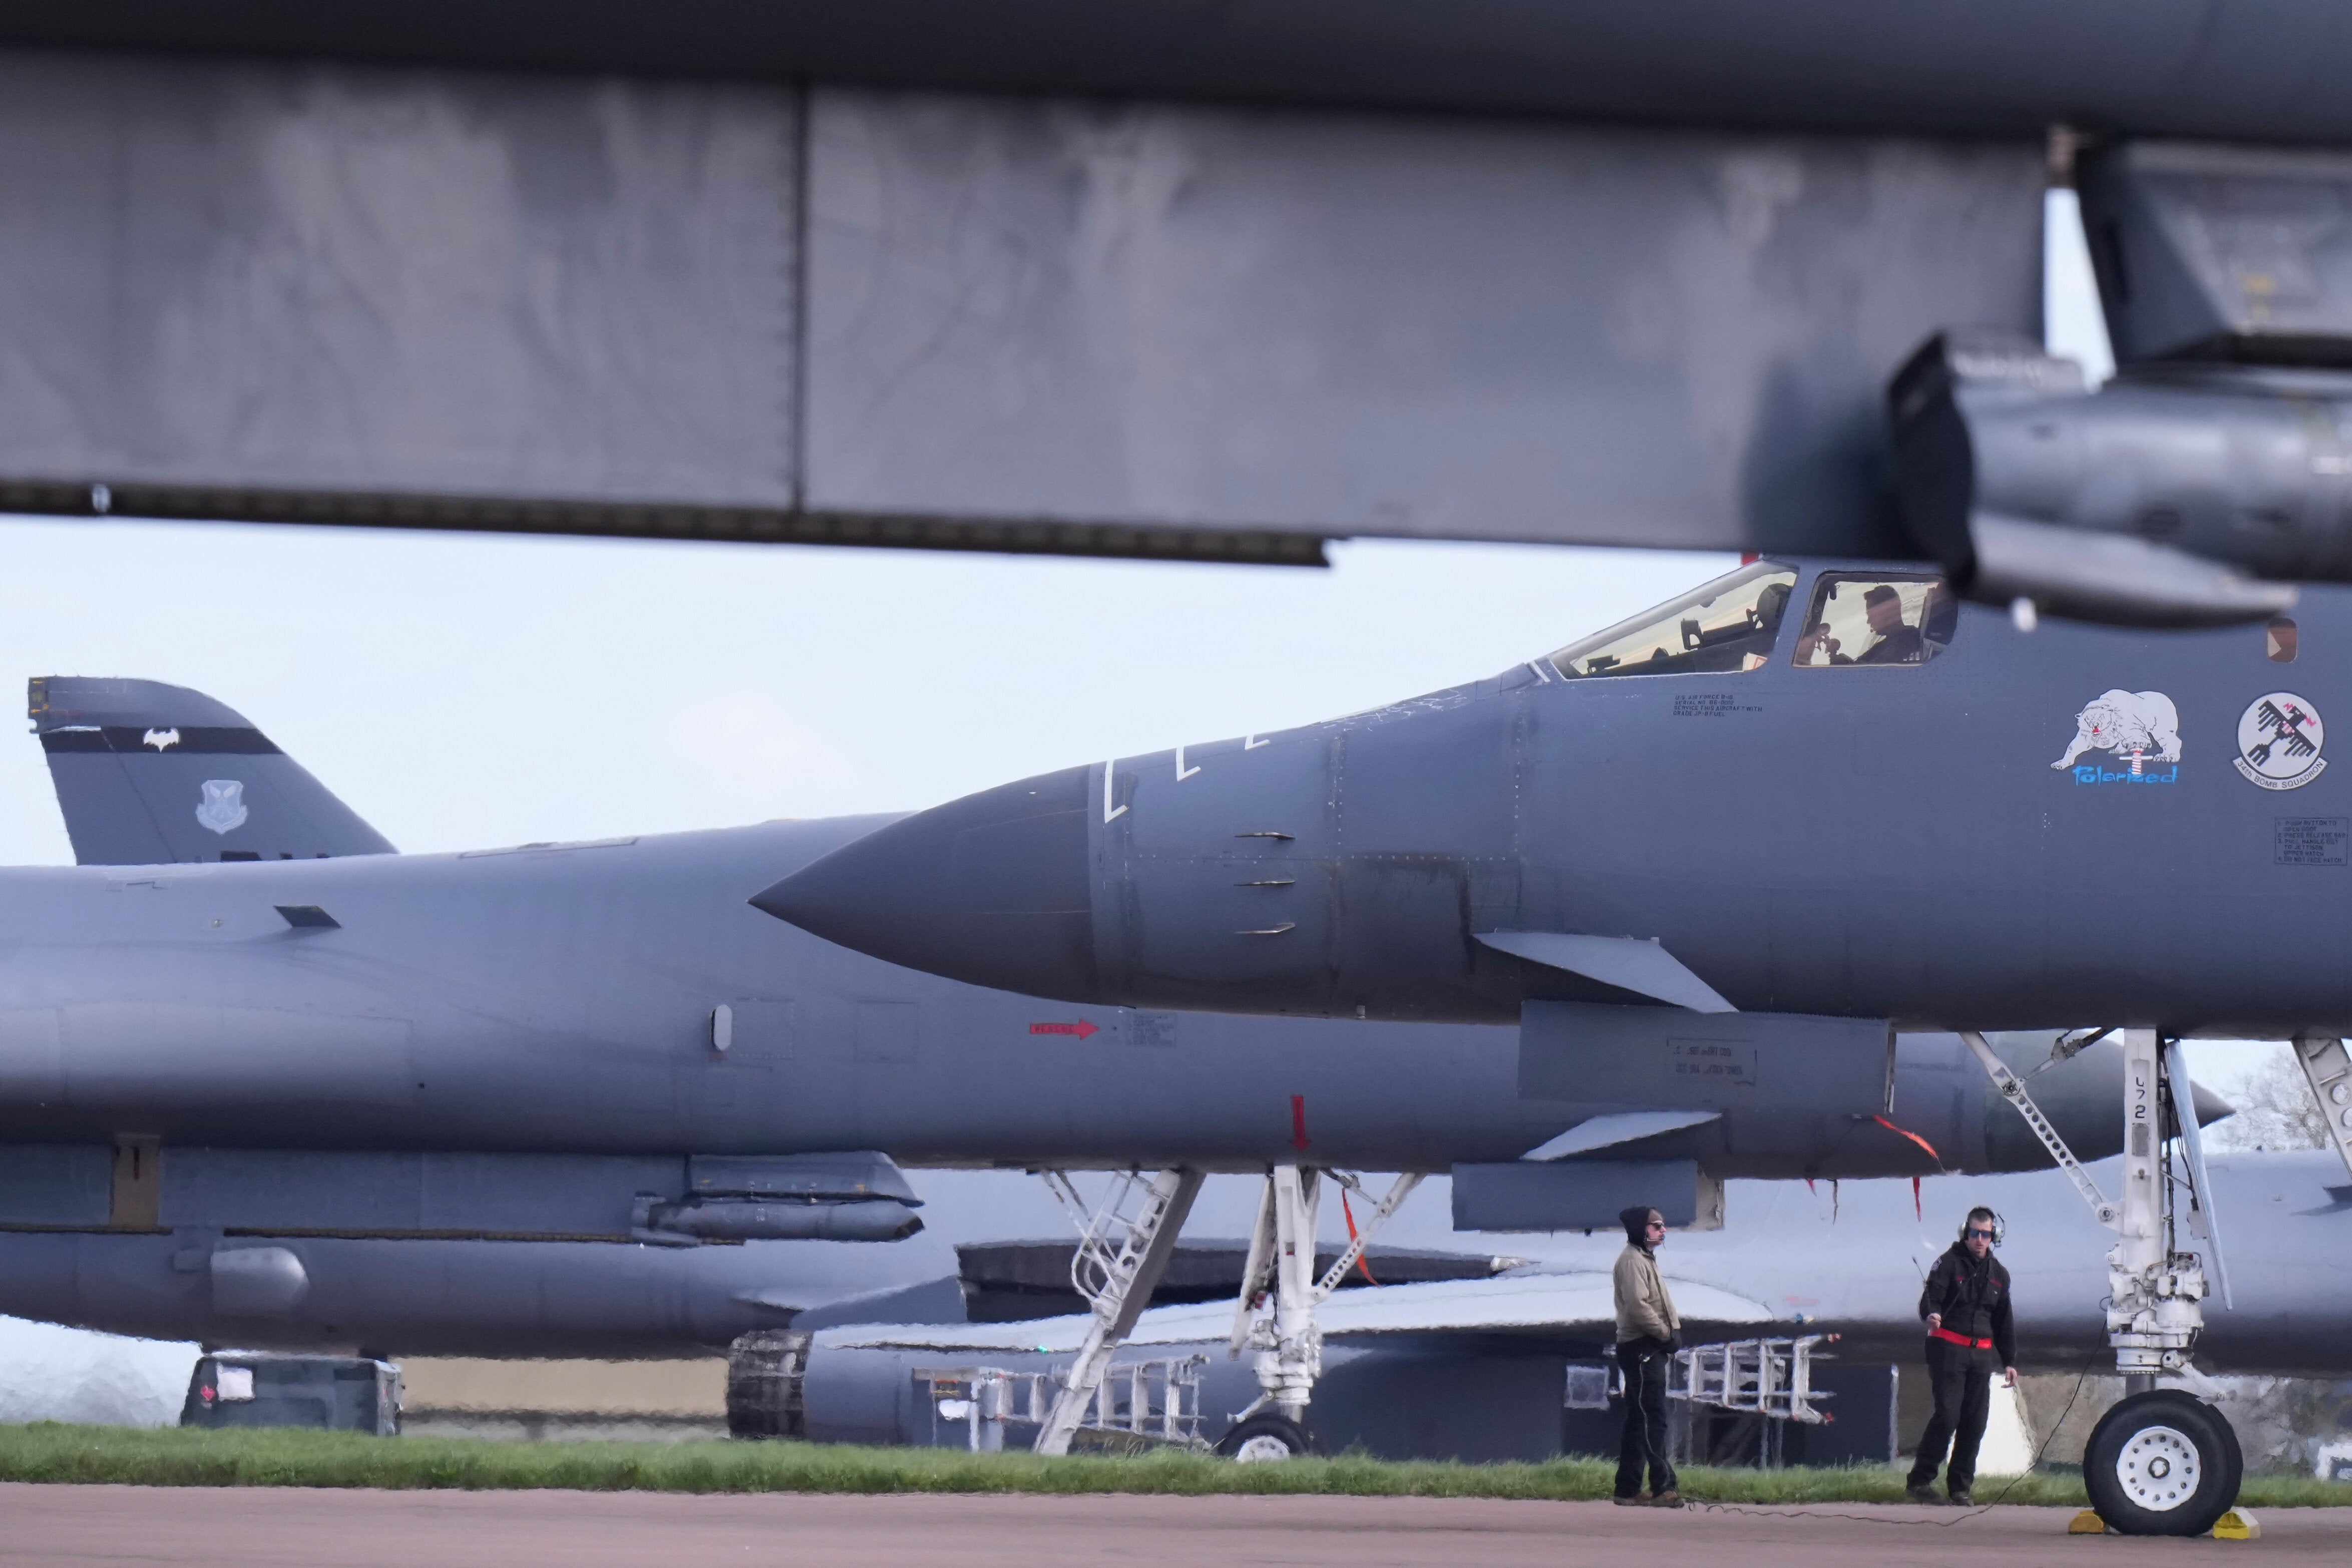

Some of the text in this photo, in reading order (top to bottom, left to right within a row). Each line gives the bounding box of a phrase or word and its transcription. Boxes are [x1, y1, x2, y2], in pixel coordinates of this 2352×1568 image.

[2072, 765, 2178, 786] Polarized
[2237, 761, 2323, 789] 34th BOMB SQUADRON
